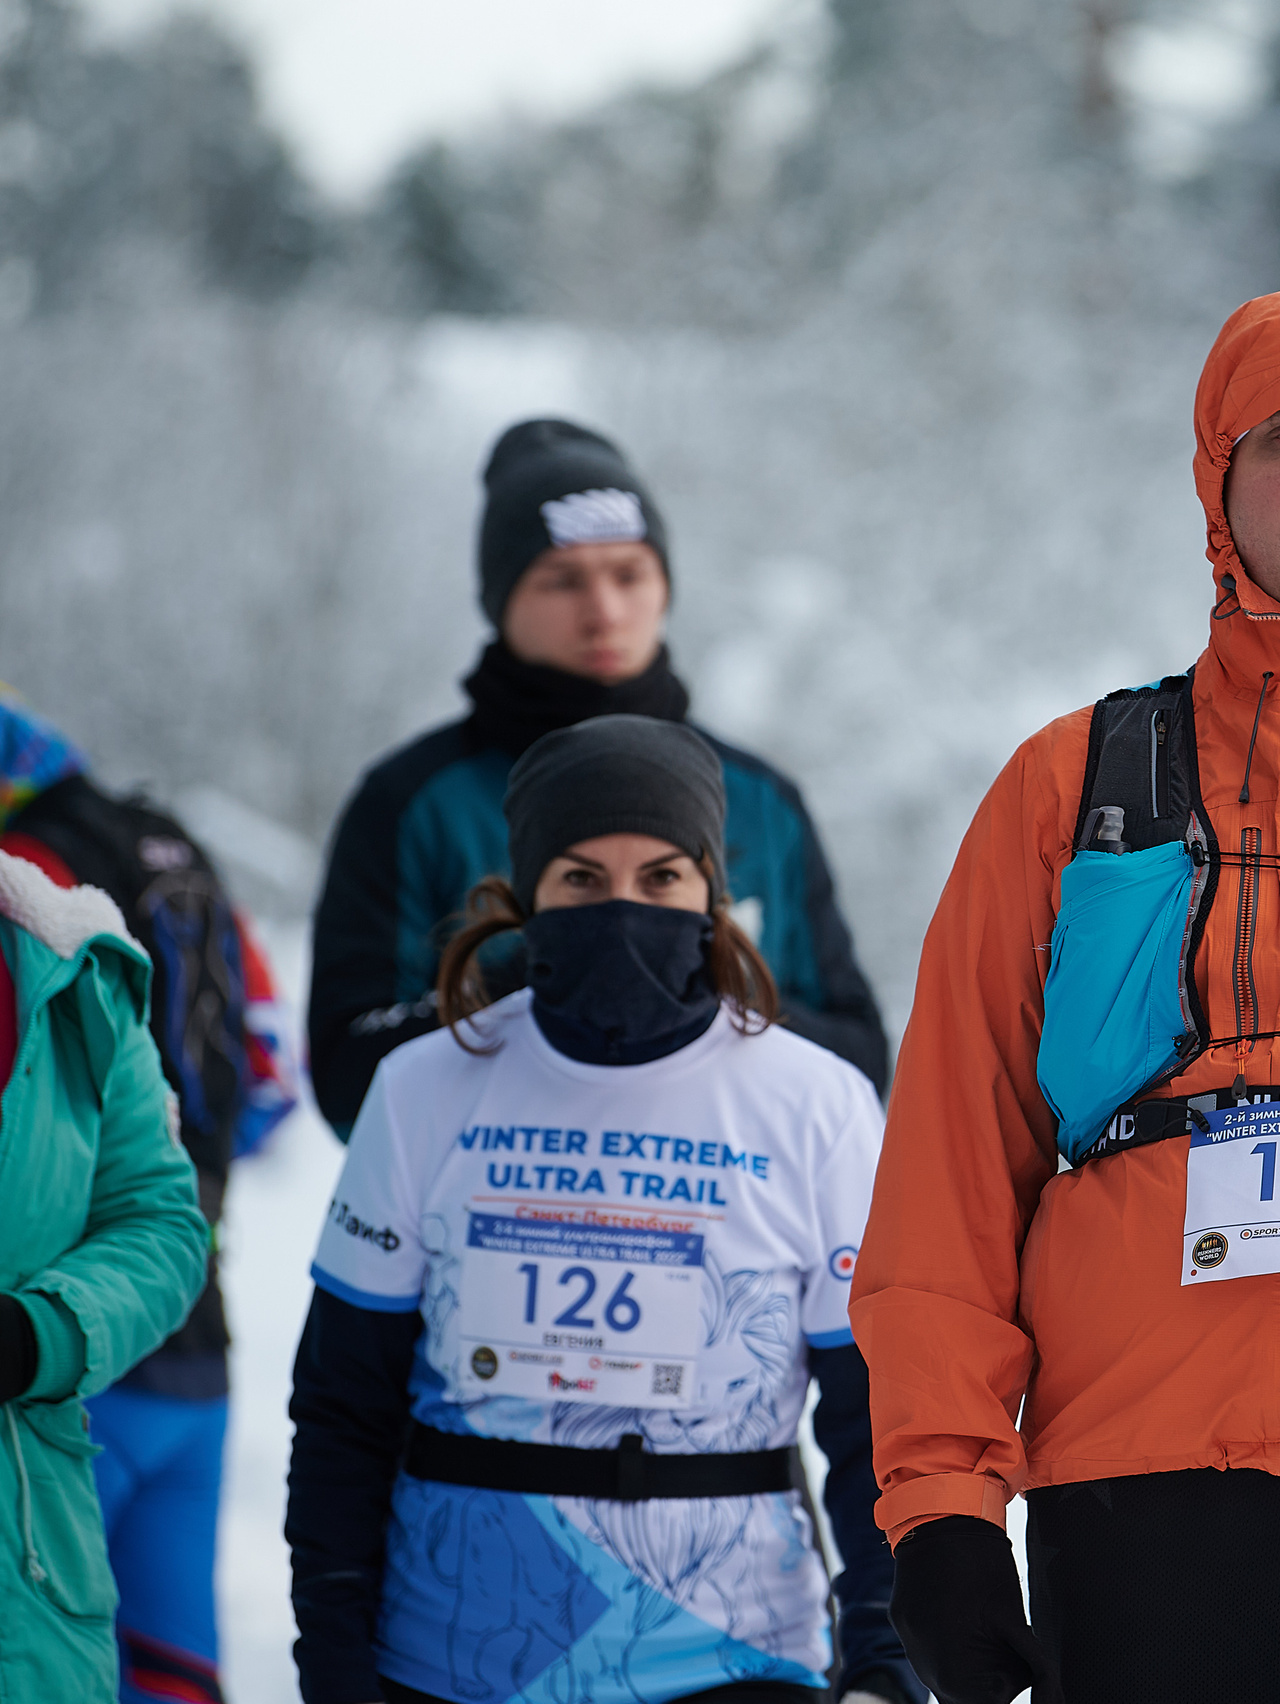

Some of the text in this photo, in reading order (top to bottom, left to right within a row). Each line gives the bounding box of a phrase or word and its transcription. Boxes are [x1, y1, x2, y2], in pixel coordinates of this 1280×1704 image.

[1206, 1125, 1257, 1142] "WINTER
[1224, 1111, 1246, 1126] 2-й
[459, 1126, 770, 1180] WINTER EXTREME
[487, 1163, 727, 1206] ULTRA TRAIL
[1199, 1252, 1220, 1261] WORLD
[518, 1262, 641, 1332] 126
